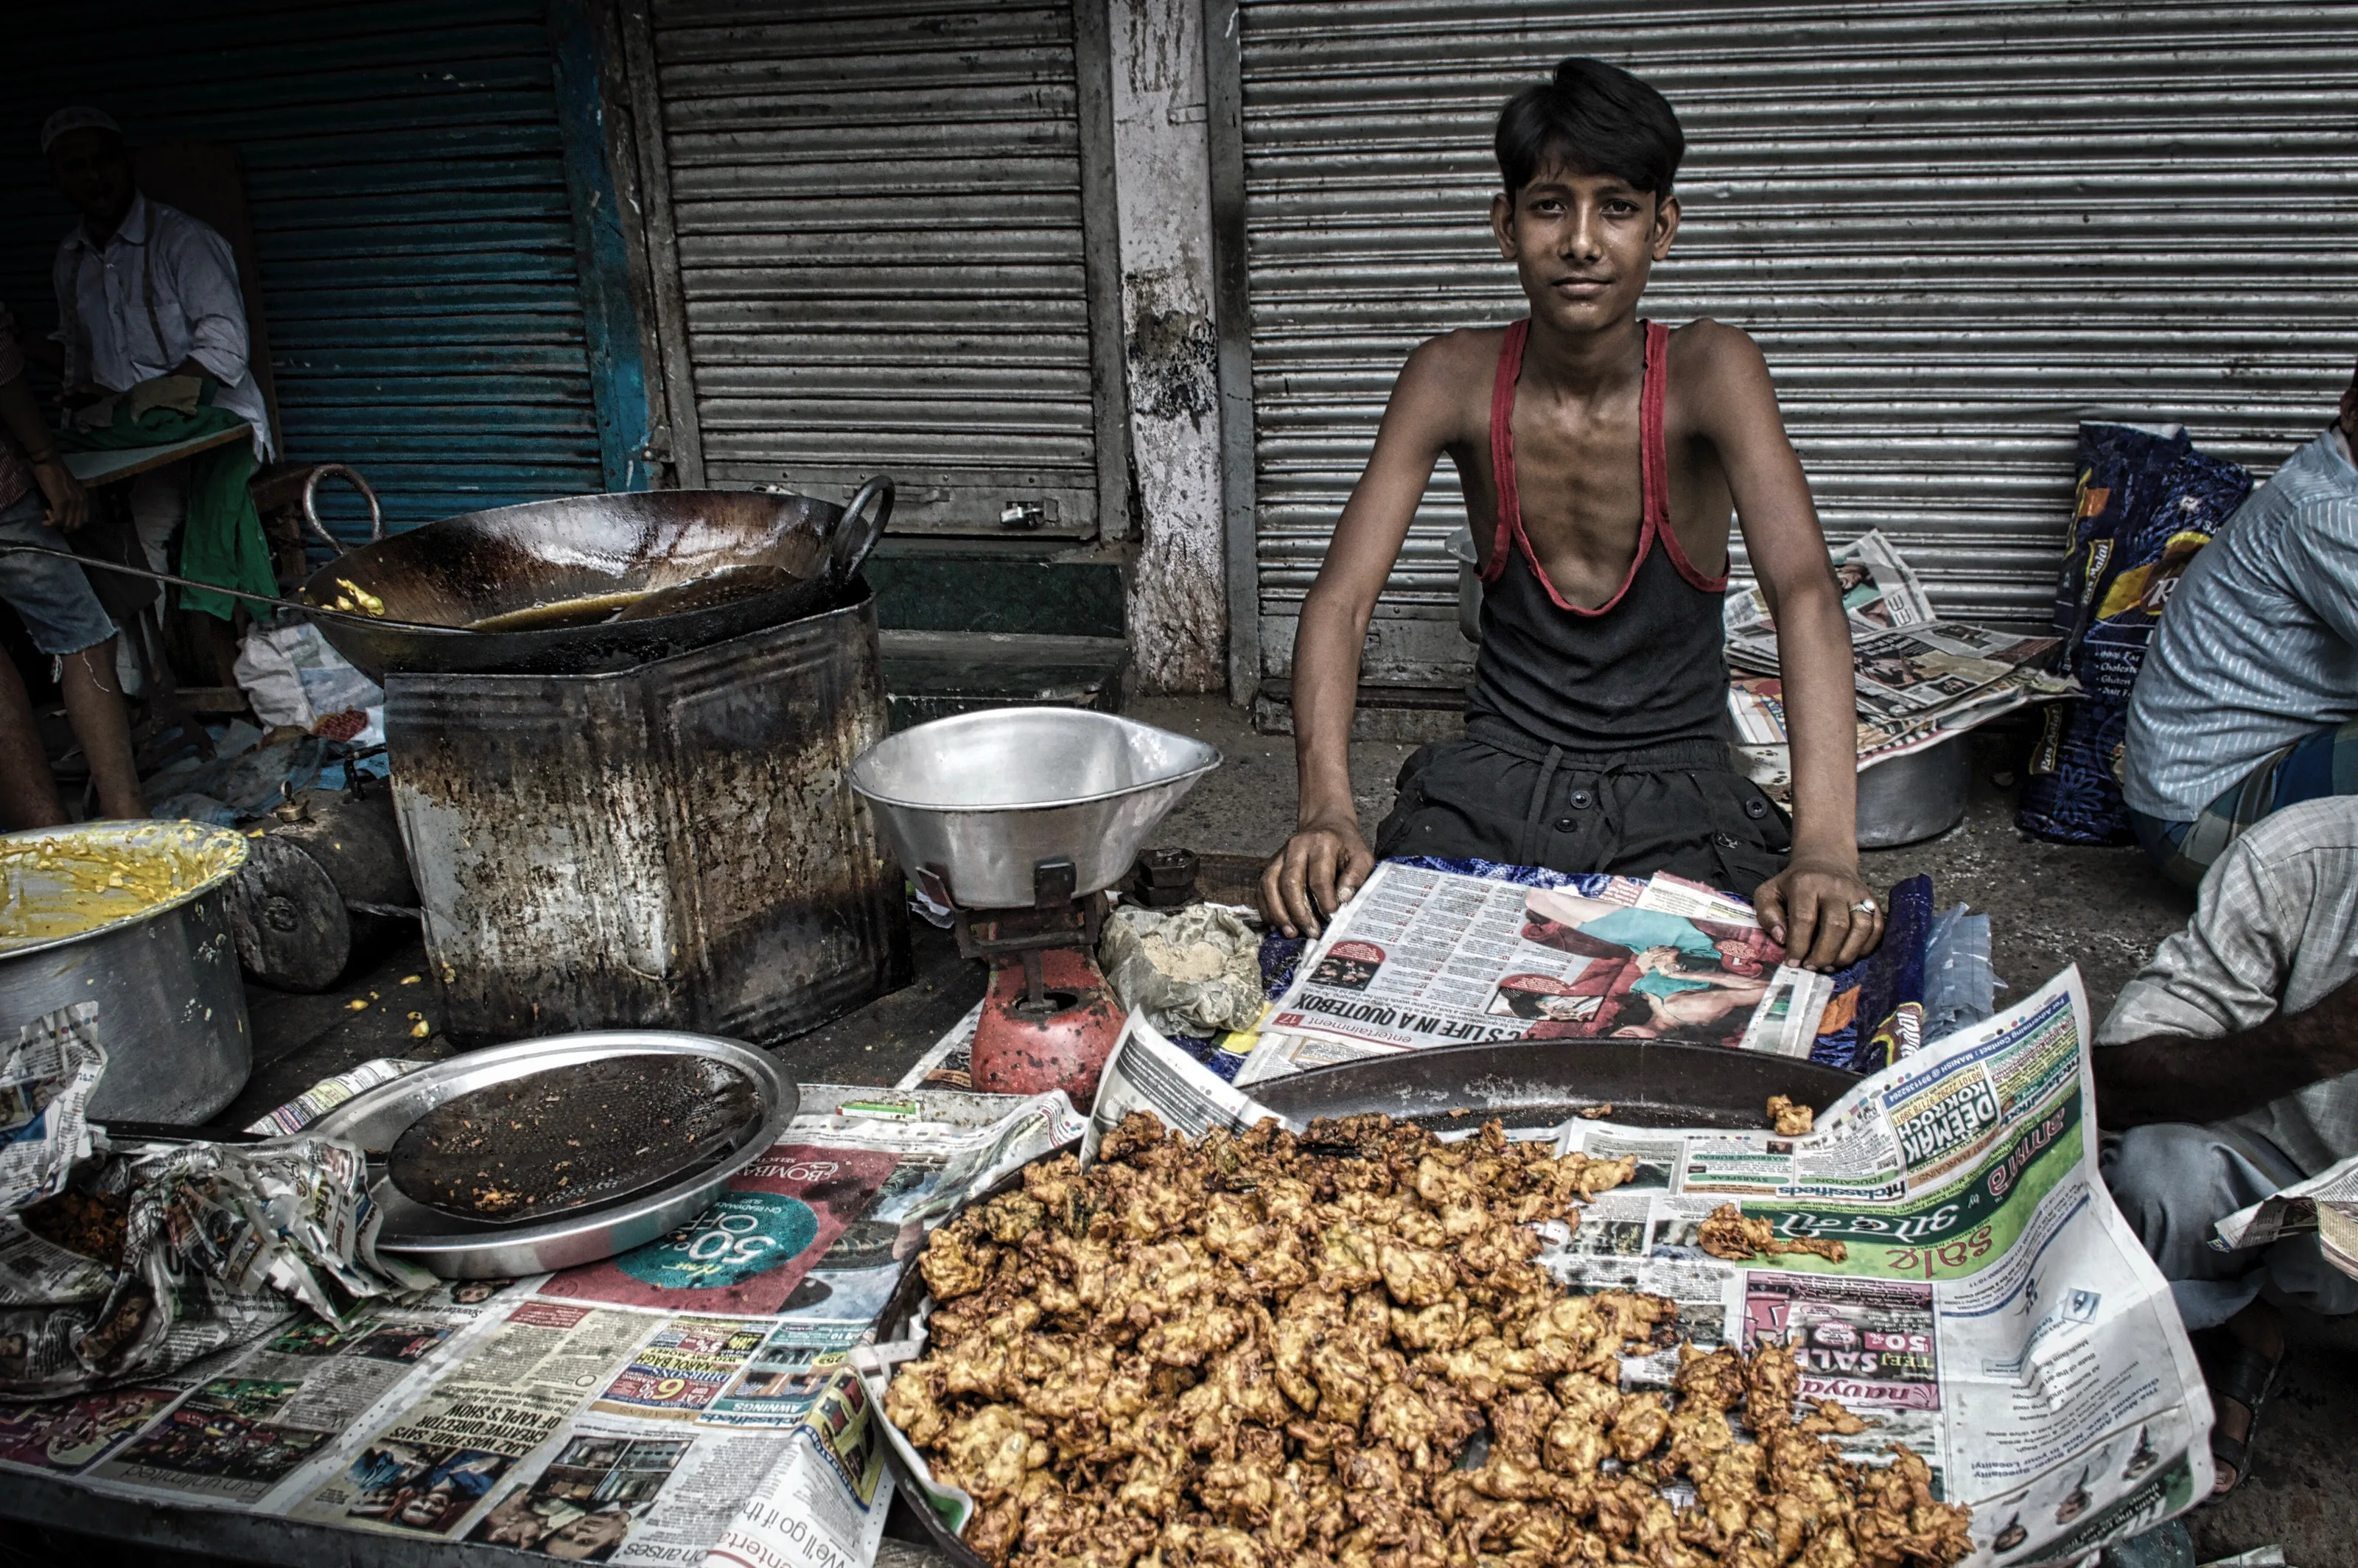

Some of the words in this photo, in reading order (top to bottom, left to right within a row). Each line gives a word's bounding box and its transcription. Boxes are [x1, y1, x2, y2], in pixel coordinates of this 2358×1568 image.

[2090, 544, 2108, 578] Malai
[1291, 993, 1396, 1026] QUOTEBOX
[2052, 998, 2065, 1012] For
[1278, 1013, 1298, 1025] 17
[1401, 1013, 1416, 1029] A
[1418, 1016, 1441, 1035] IN
[2011, 1007, 2051, 1038] Advertising
[1308, 1017, 1411, 1045] entertainment
[1444, 1020, 1485, 1044] LIFE
[1979, 1035, 2011, 1054] Contact
[1941, 1052, 1973, 1071] MANISH
[1957, 1070, 1983, 1088] 98101
[1889, 1074, 1932, 1102] 9911352264
[1897, 1081, 1984, 1138] KOKROCH
[1911, 1095, 1936, 1113] 97178
[1892, 1107, 1914, 1124] 39911
[1903, 1096, 1993, 1163] DEEMAK
[1916, 1149, 1973, 1184] BARGAINS
[1816, 1175, 1883, 1186] EDUCATION
[1777, 1180, 1906, 1200] htclassifieds
[677, 1211, 758, 1233] OFF
[443, 1302, 482, 1320] Spandan
[650, 1347, 684, 1357] MORE?
[695, 1339, 723, 1354] 5%
[2054, 1340, 2087, 1361] Mediclaim
[634, 1352, 672, 1368] BAGH
[673, 1357, 713, 1372] KAROL
[688, 1353, 709, 1361] PAY
[712, 1355, 736, 1363] WHY
[1794, 1348, 1877, 1373] SALE
[1881, 1353, 1929, 1368] TEEJ
[650, 1364, 729, 1384] DHIRSONS
[444, 1381, 477, 1395] publicity
[477, 1386, 490, 1395] for
[490, 1387, 514, 1399] name
[1801, 1379, 1910, 1401] navya
[2110, 1379, 2160, 1410] Glaucoma
[2138, 1387, 2158, 1399] The
[480, 1394, 497, 1404] that
[498, 1396, 521, 1407] claim
[522, 1399, 553, 1413] makers
[677, 1391, 710, 1404] FLAT
[442, 1404, 489, 1417] SHOW
[553, 1405, 567, 1415] The
[732, 1402, 801, 1413] AWNINGS
[2113, 1401, 2139, 1418] Most
[415, 1416, 485, 1434] DIRECTOR
[488, 1407, 542, 1428] KAPIL'S
[537, 1416, 560, 1429] OF
[2019, 1407, 2047, 1427] experts
[388, 1427, 428, 1441] SAYS
[433, 1430, 462, 1446] PAID,
[485, 1423, 548, 1443] CREATIVE
[2061, 1432, 2083, 1446] Now
[2064, 1419, 2114, 1451] Advanced
[461, 1435, 494, 1451] WAS
[495, 1441, 536, 1456] AJAZ
[1971, 1460, 2021, 1470] Locality!
[2024, 1451, 2046, 1466] your
[119, 1466, 220, 1494] unlimited
[223, 1479, 268, 1497] Fun
[758, 1508, 779, 1530] if
[779, 1516, 807, 1545] go
[802, 1533, 846, 1568] We'll
